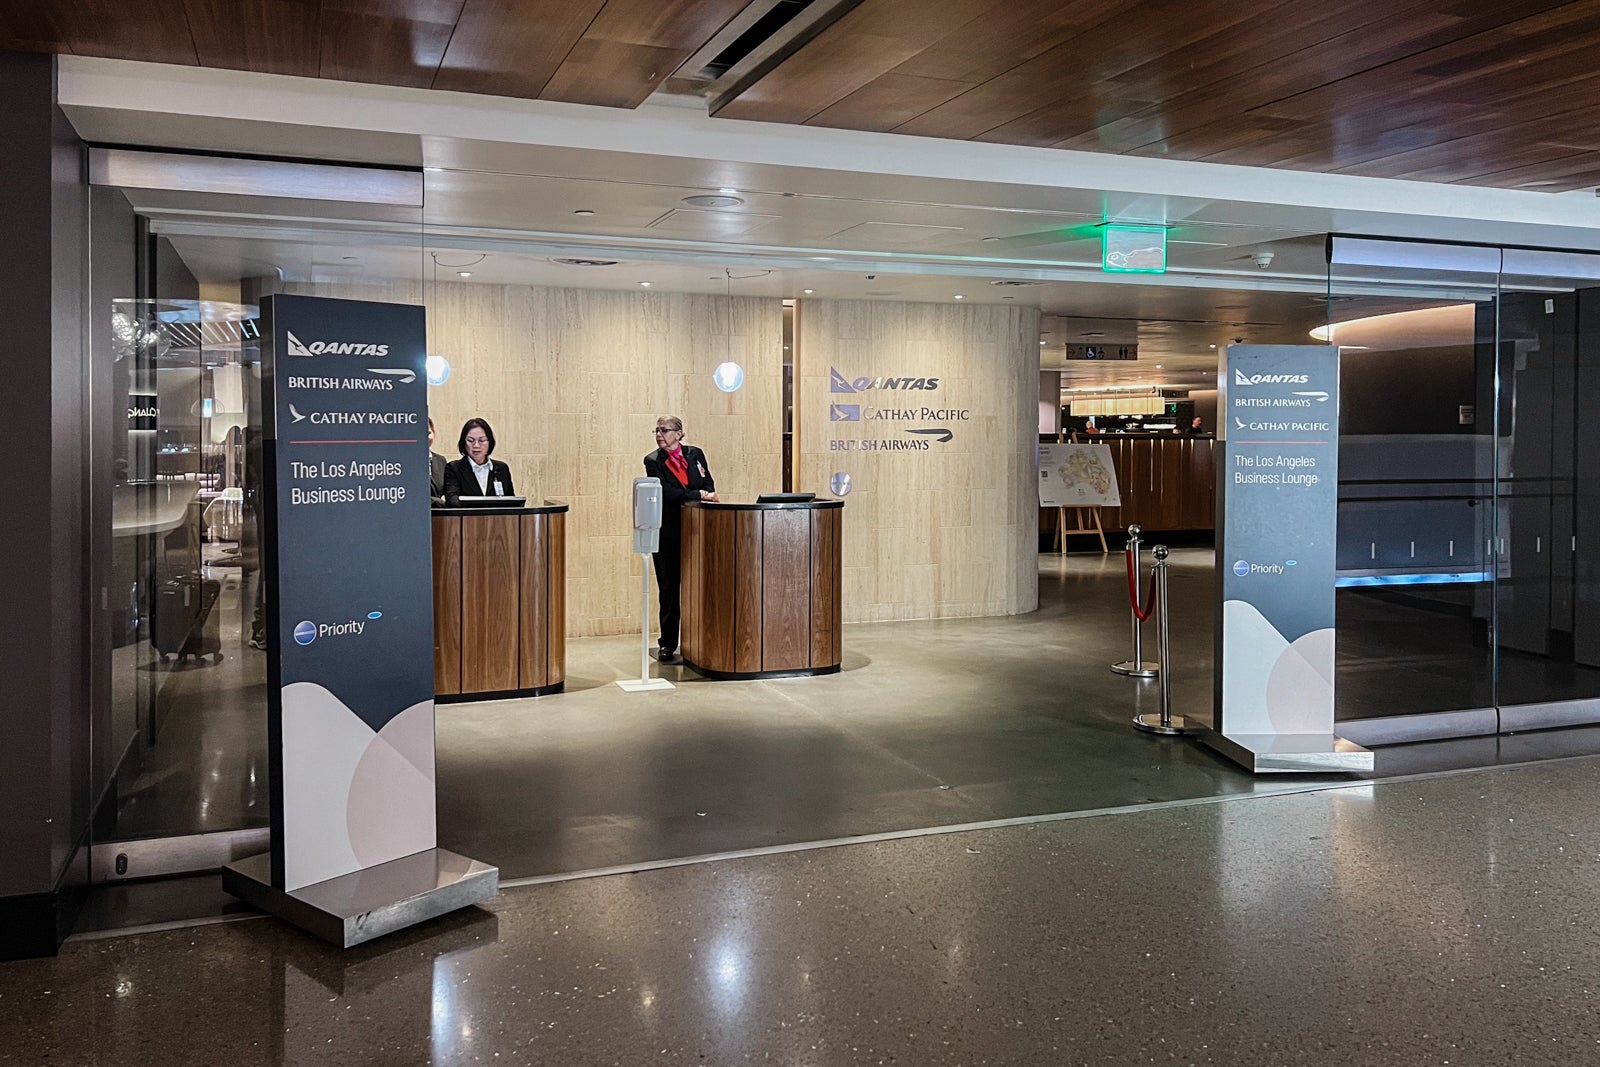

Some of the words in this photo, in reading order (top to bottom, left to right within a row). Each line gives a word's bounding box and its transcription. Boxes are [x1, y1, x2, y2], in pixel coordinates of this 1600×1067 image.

[309, 341, 389, 356] QANTAS
[288, 377, 339, 389] BRITISH
[342, 379, 393, 390] AIRWAYS
[853, 377, 939, 391] QANTAS
[1251, 375, 1309, 384] QANTAS
[1235, 399, 1271, 407] BRITISH
[1272, 399, 1311, 407] AIRWAYS
[311, 413, 366, 424] CATHAY
[369, 413, 417, 424] PACIFIC
[921, 408, 969, 420] PACIFIC
[1250, 422, 1290, 431] CATHAY
[1292, 422, 1329, 431] PACIFIC
[830, 440, 877, 450] BRITISH
[880, 440, 929, 450] AIRWAYS
[1235, 455, 1253, 467] The
[1257, 455, 1273, 467] Los
[1276, 455, 1315, 470] Angeles
[291, 462, 317, 479] The
[322, 462, 345, 477] Los
[349, 460, 401, 480] Angeles
[1235, 472, 1279, 484] Business
[1282, 472, 1317, 487] Lounge
[292, 487, 354, 505] Business
[358, 485, 405, 504] Lounge
[1251, 564, 1284, 574] Priority
[320, 620, 365, 637] Priority
